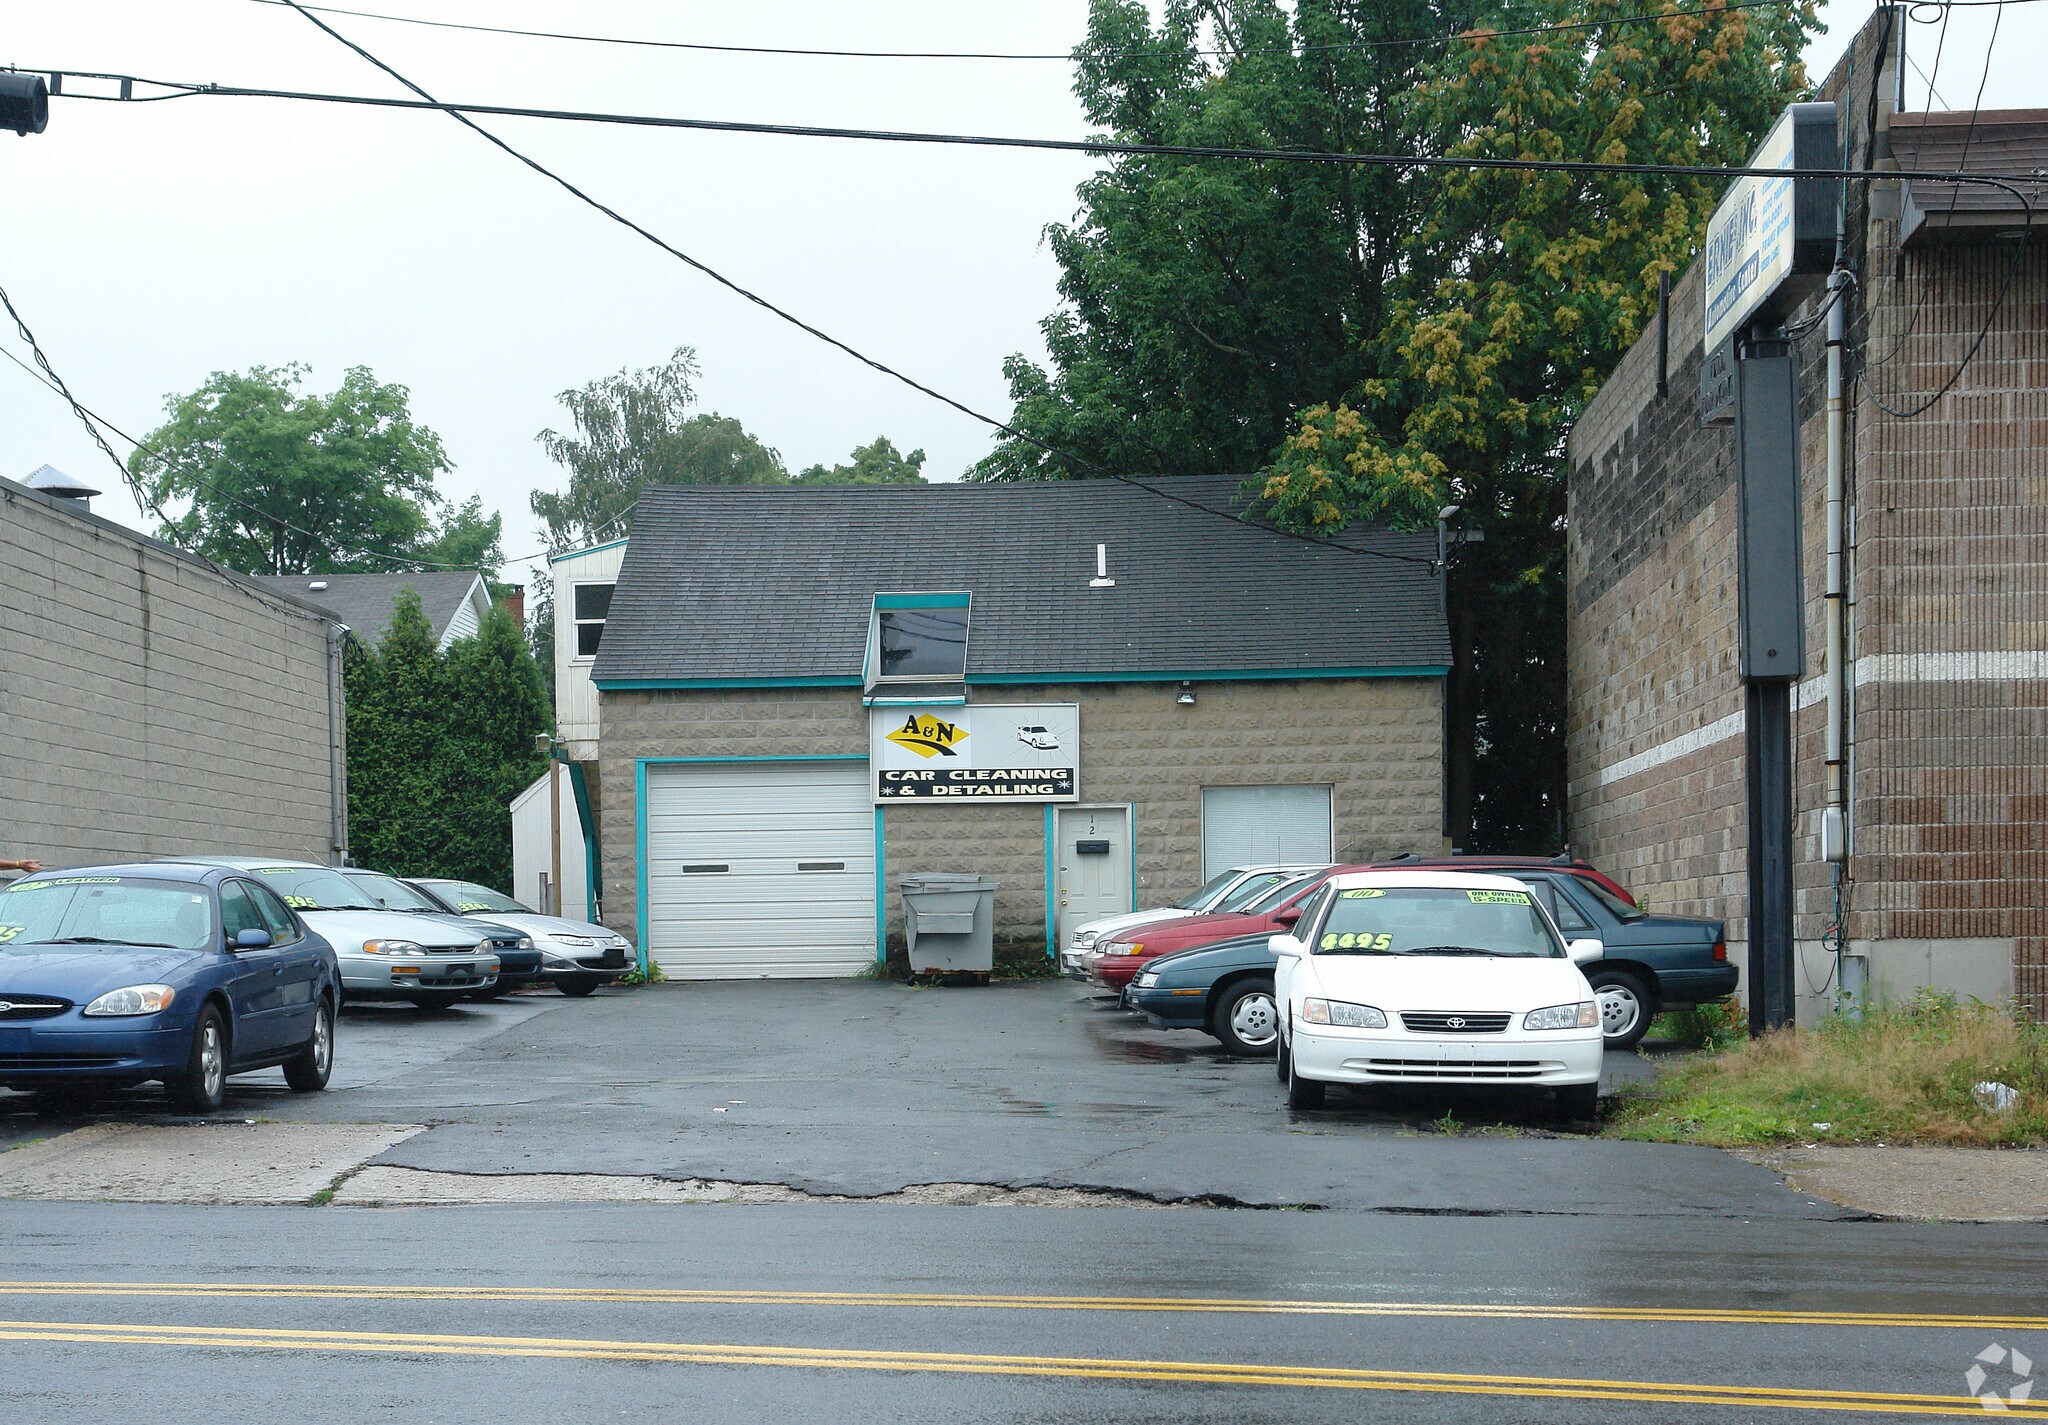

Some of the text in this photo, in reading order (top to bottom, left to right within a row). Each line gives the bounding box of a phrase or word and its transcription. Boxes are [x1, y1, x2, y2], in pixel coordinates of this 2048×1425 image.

[885, 769, 1068, 781] CAR CLEANING
[899, 784, 1054, 796] & DETAILING
[57, 877, 118, 885] LEATHER
[1473, 896, 1527, 904] 5-SPEED
[1320, 932, 1393, 952] 4495
